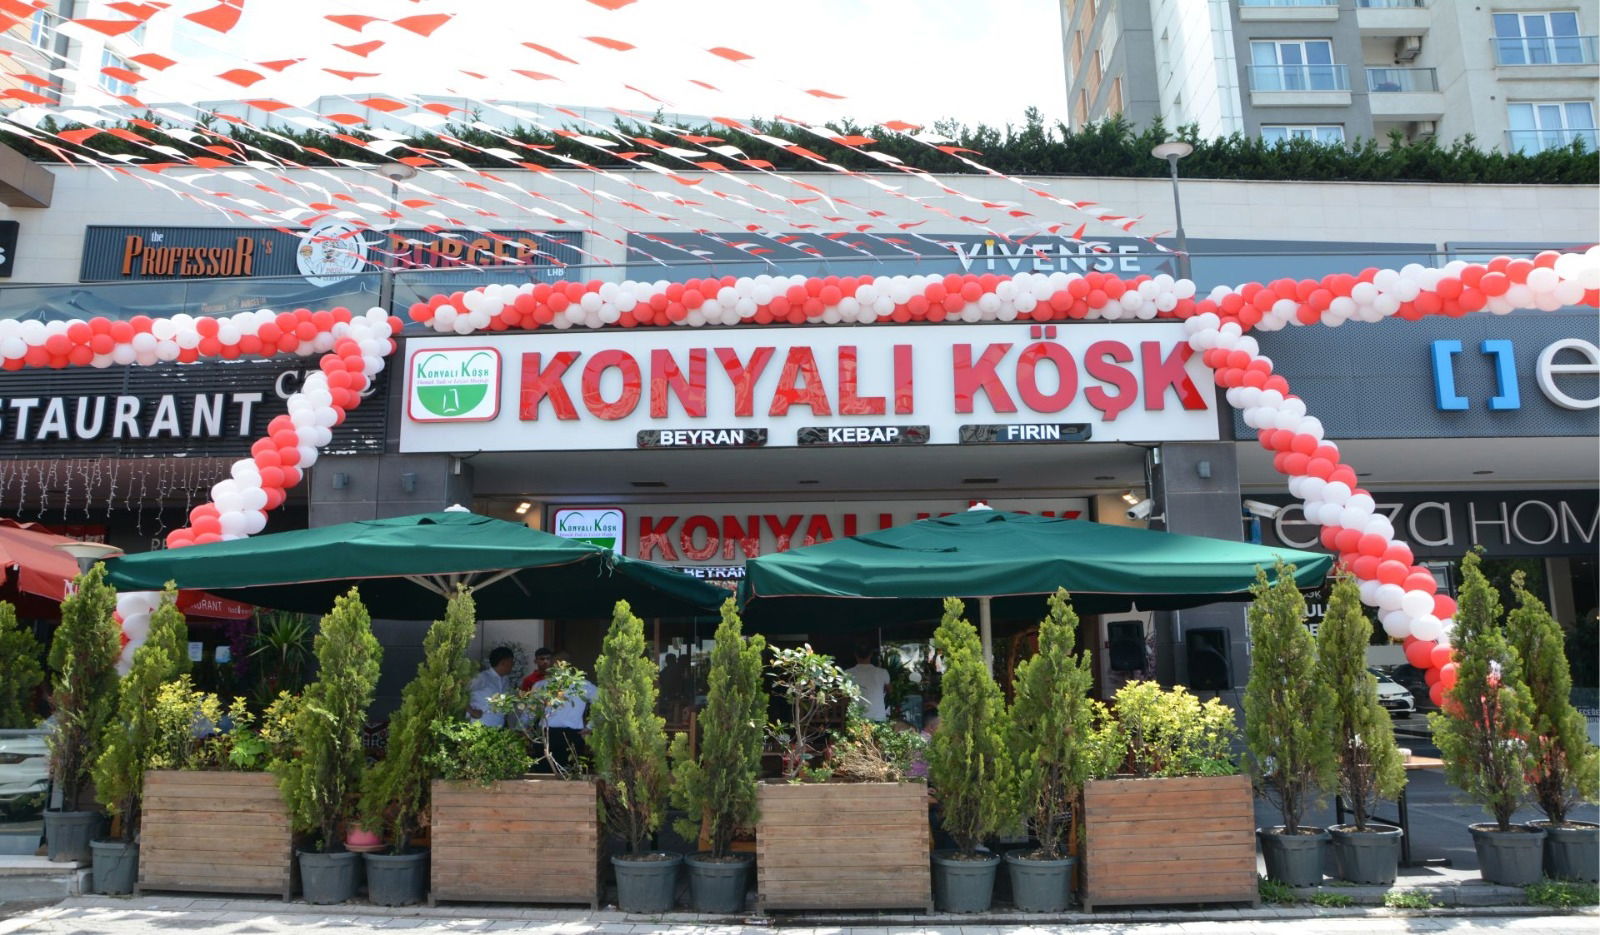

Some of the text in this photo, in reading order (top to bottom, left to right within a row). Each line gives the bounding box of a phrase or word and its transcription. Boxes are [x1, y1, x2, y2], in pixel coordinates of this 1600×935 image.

[151, 231, 164, 242] the
[391, 235, 538, 272] BURGER
[952, 240, 1141, 271] VIVENSE
[519, 325, 1208, 421] KONYALI KÖŞK
[0, 392, 263, 440] TAURANT
[660, 430, 744, 446] BEYRAN
[828, 426, 899, 443] KEBAP
[1007, 424, 1060, 441] FIRIN
